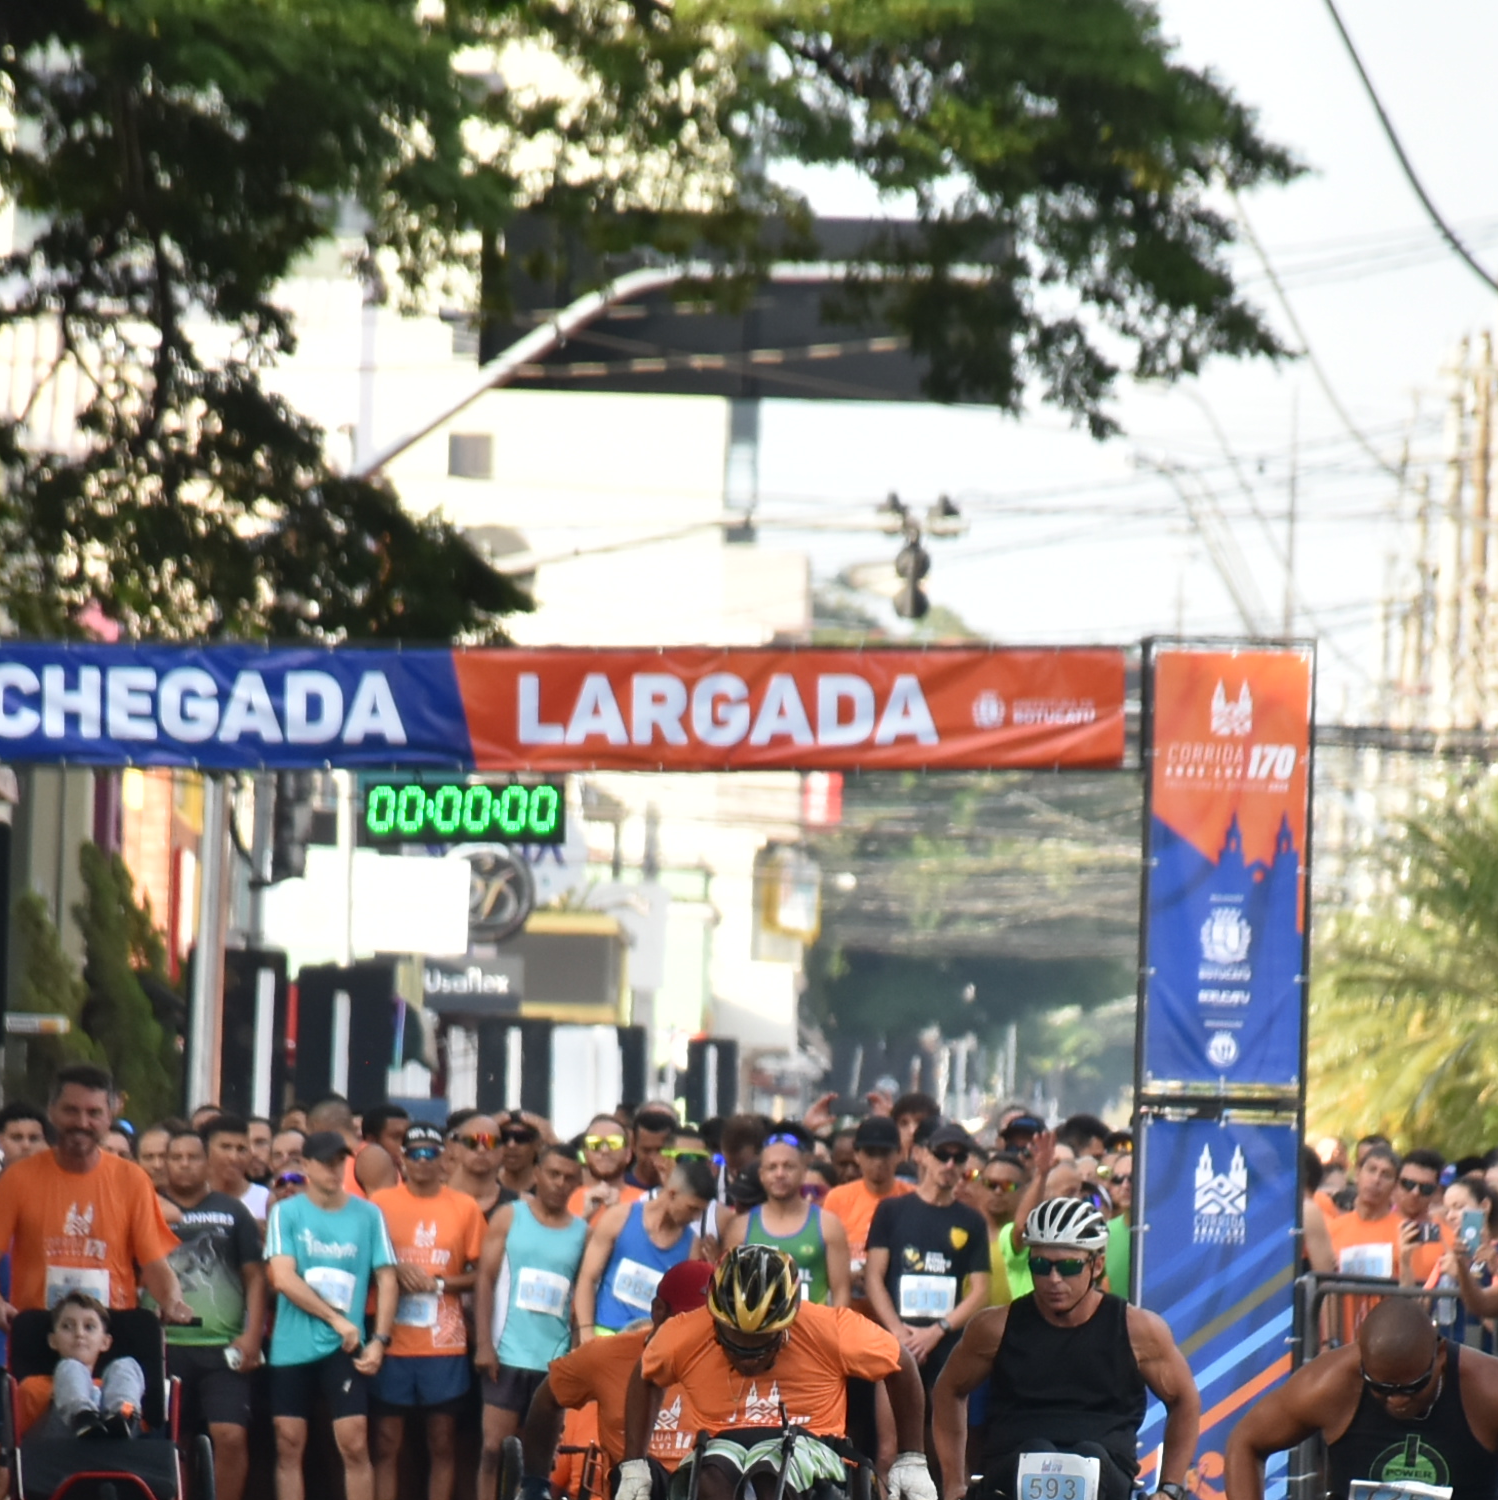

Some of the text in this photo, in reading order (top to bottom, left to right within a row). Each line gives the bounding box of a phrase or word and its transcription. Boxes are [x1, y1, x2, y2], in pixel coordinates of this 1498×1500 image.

[517, 672, 940, 746] LARGADA
[1013, 707, 1097, 725] BOTUCATU
[1167, 742, 1244, 765] CORRIDA
[1247, 743, 1297, 781] 170
[366, 785, 559, 832] 00:00:00
[424, 966, 511, 994] Usaflex
[182, 1211, 235, 1227] UNNERS
[1385, 1469, 1433, 1479] POWER
[1029, 1478, 1077, 1500] 593
